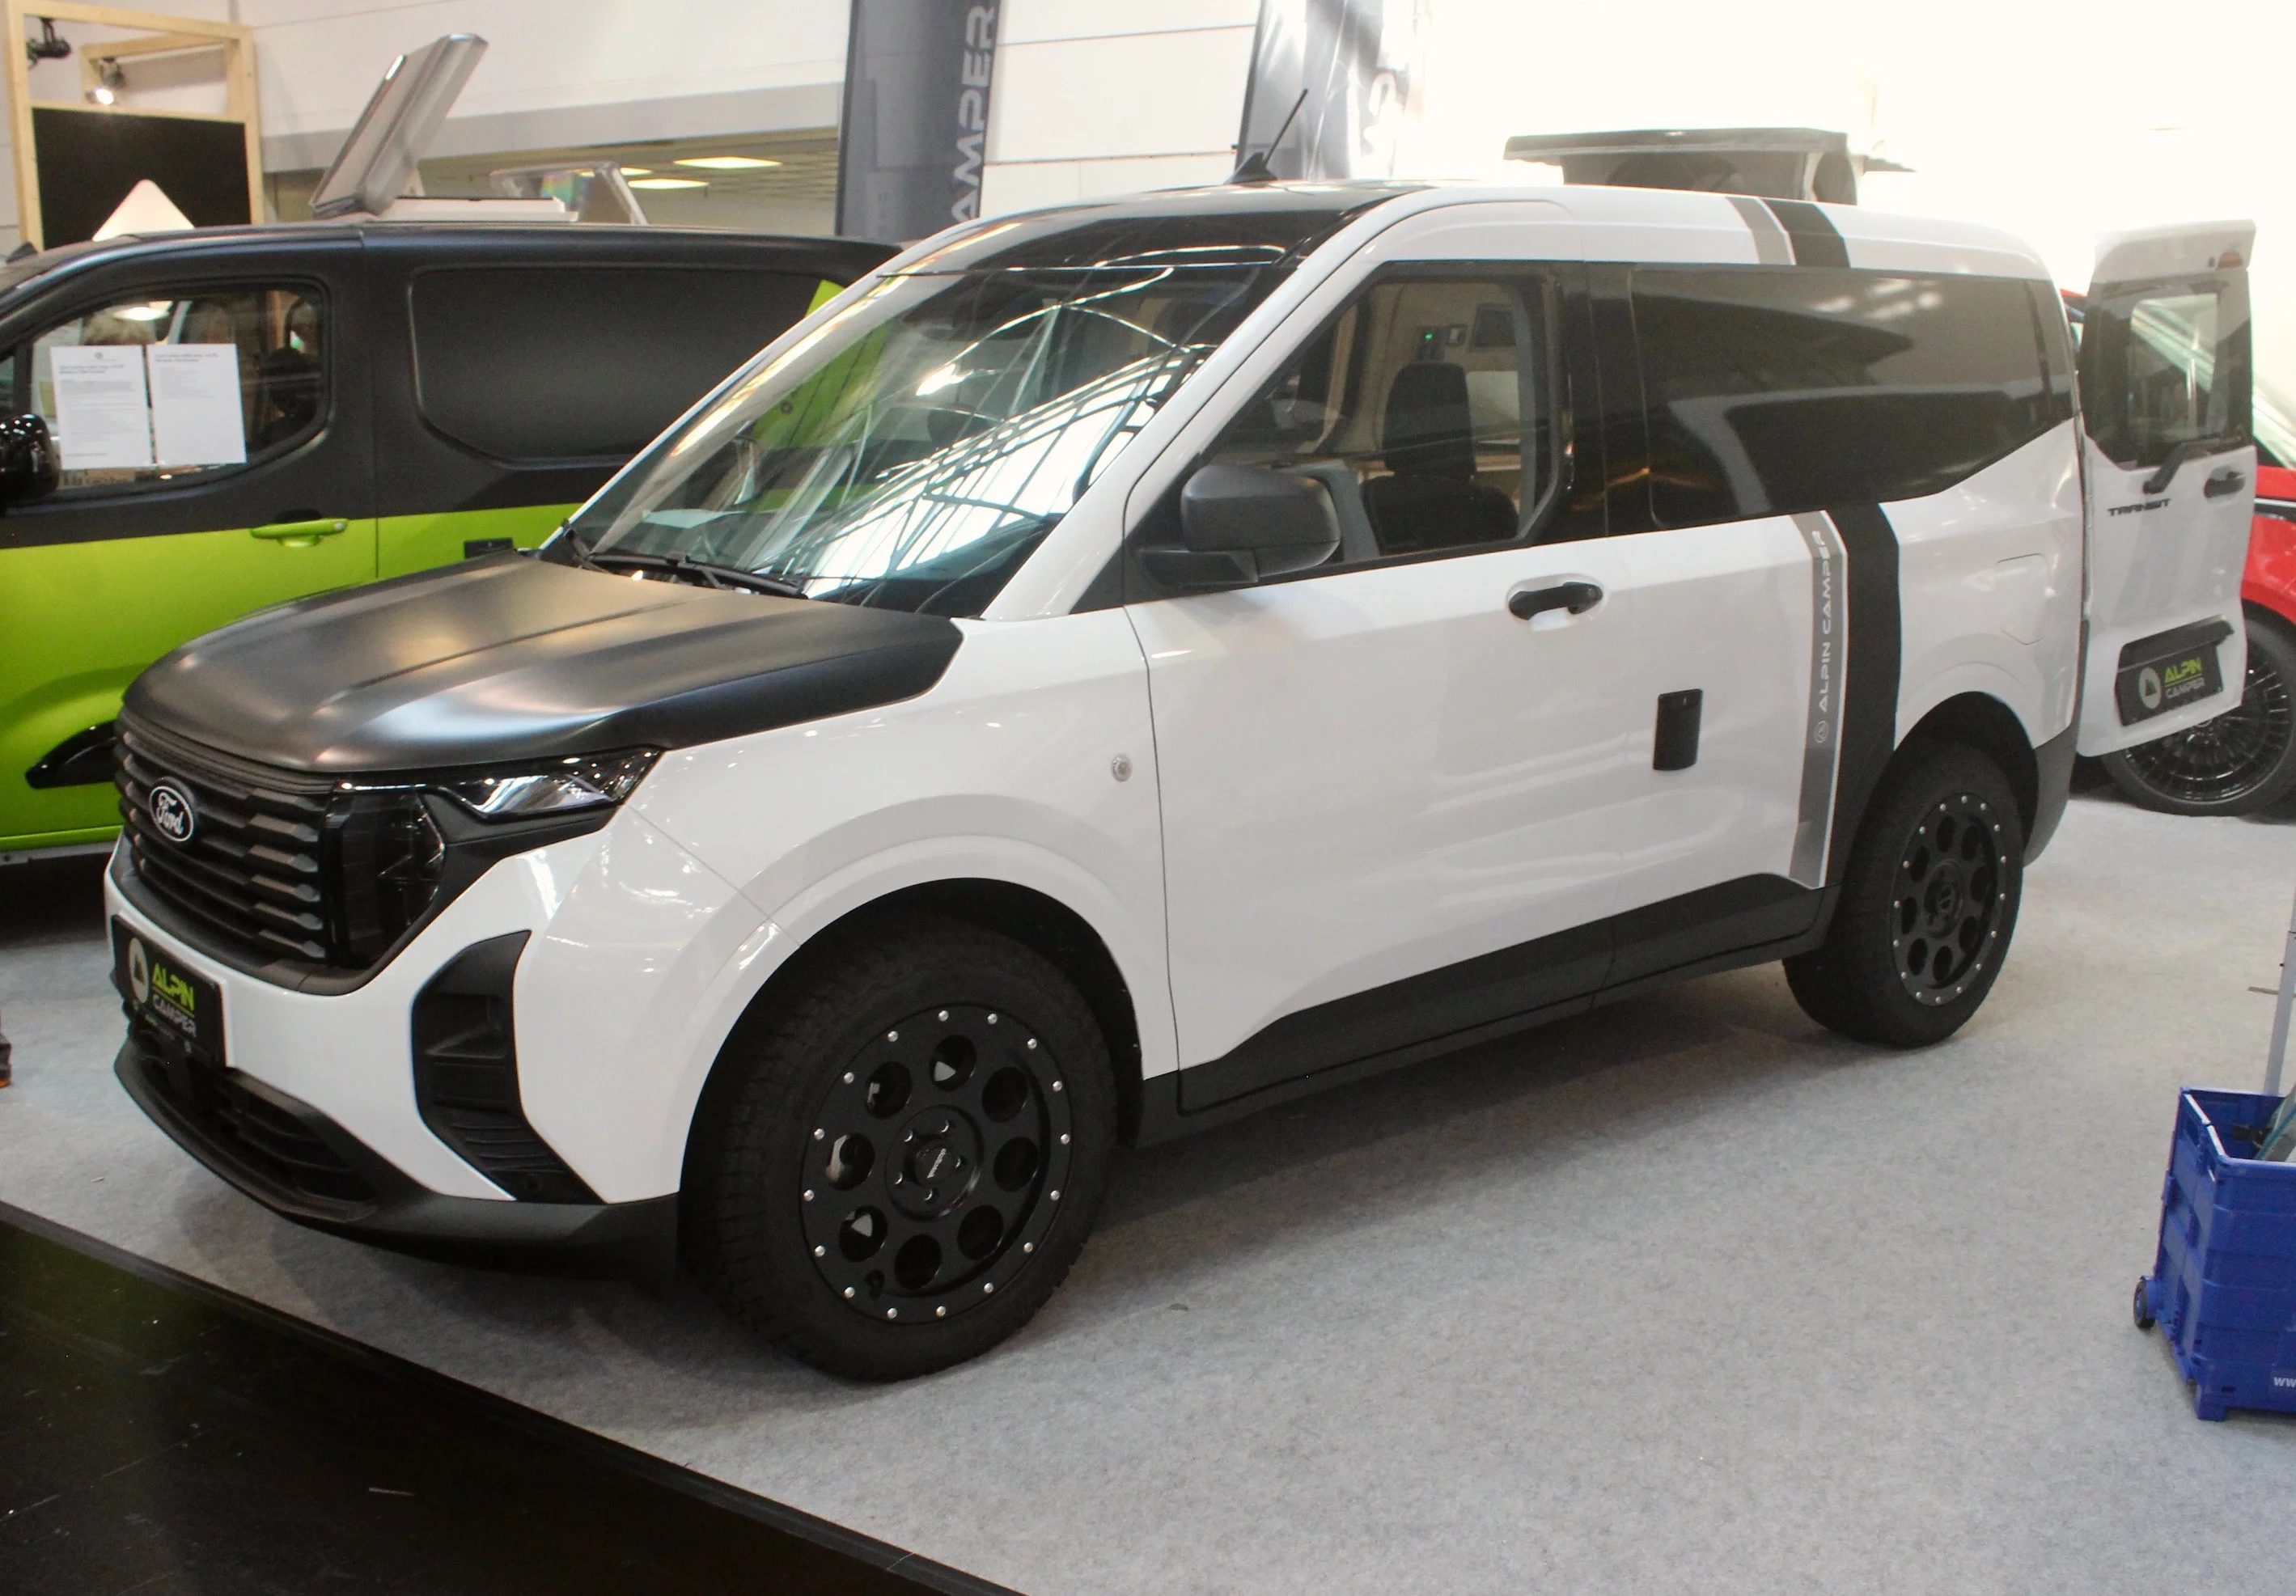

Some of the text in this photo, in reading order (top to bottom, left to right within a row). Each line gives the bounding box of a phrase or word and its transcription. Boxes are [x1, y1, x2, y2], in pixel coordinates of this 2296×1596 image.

[1811, 530, 1832, 713] ALPIN CAMPER
[2165, 658, 2203, 684] ALPIN
[2166, 676, 2205, 699] CAMPER
[155, 790, 186, 836] Ford
[152, 963, 195, 1011] ALPIN
[153, 994, 197, 1038] CAMPER
